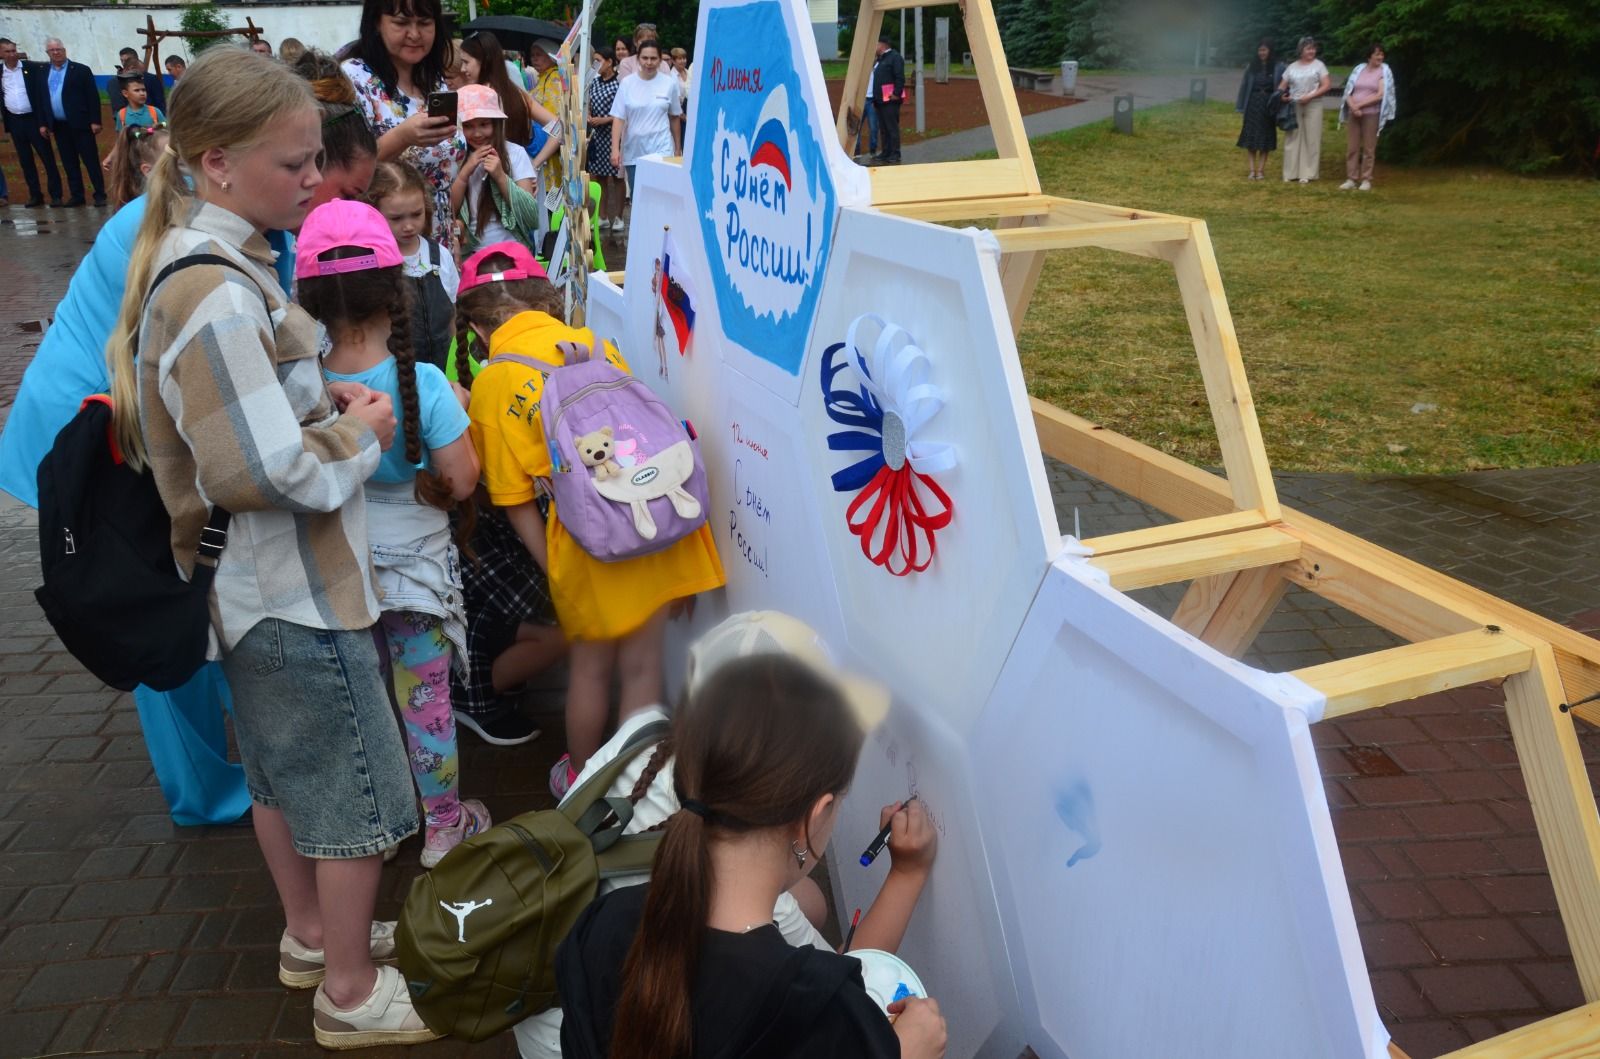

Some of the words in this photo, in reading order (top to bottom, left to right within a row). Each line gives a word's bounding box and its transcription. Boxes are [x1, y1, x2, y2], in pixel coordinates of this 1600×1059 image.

[710, 56, 726, 94] 12
[727, 67, 764, 93] июня
[720, 138, 730, 194] С
[726, 201, 811, 285] России!
[731, 421, 743, 444] 12
[634, 469, 656, 483] CLASSIC
[734, 458, 743, 505] С
[730, 510, 768, 579] России!
